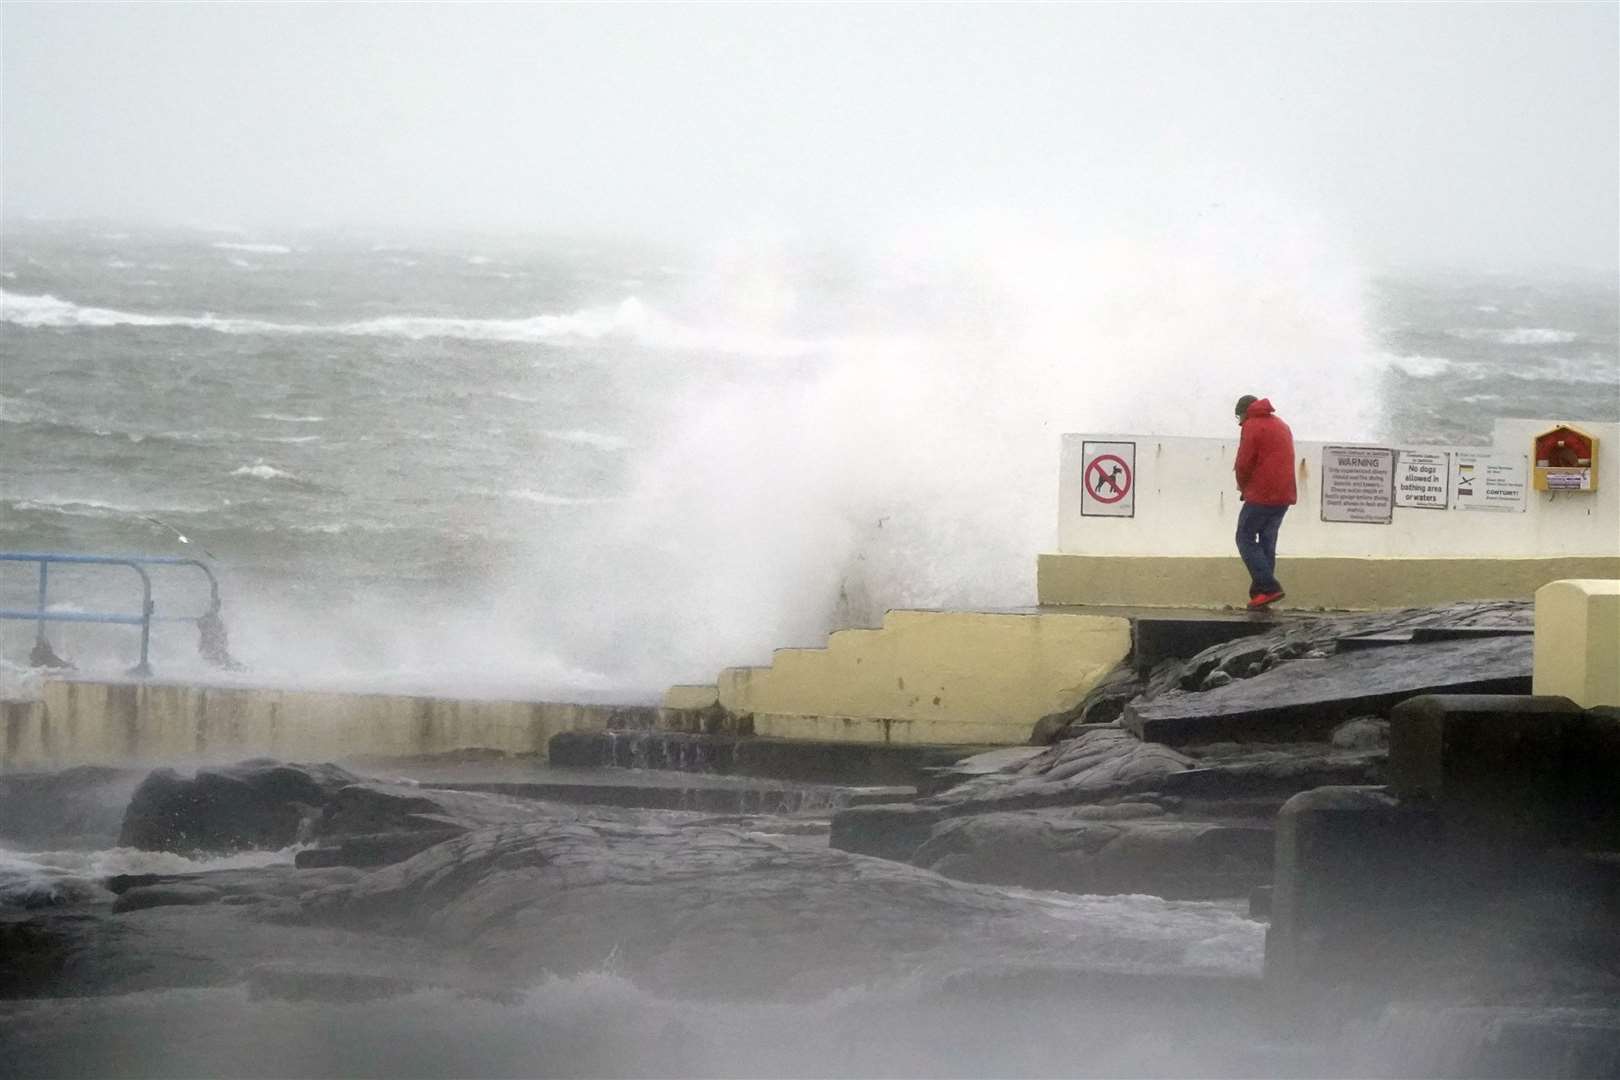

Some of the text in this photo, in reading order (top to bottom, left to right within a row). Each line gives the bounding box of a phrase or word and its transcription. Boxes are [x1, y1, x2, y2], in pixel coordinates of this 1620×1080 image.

[1338, 458, 1379, 467] WARNING
[1420, 466, 1436, 474] dogs
[1400, 484, 1425, 492] bathing
